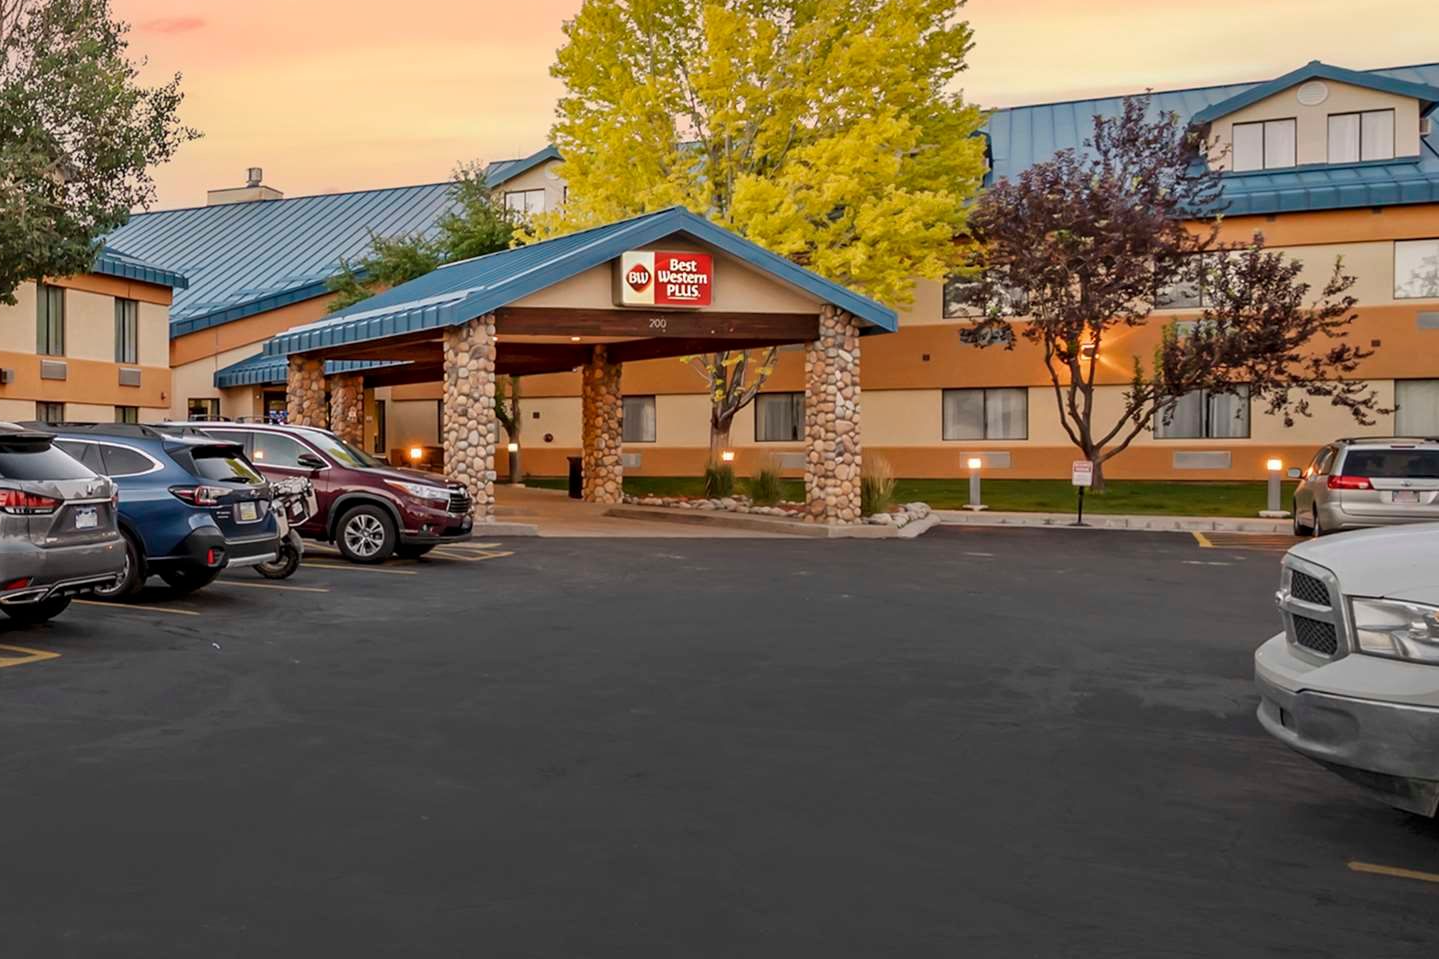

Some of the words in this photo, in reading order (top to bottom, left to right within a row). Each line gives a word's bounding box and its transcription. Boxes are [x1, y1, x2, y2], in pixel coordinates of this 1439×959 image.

[670, 259, 697, 271] Best
[628, 272, 649, 284] BW
[658, 270, 707, 284] Western
